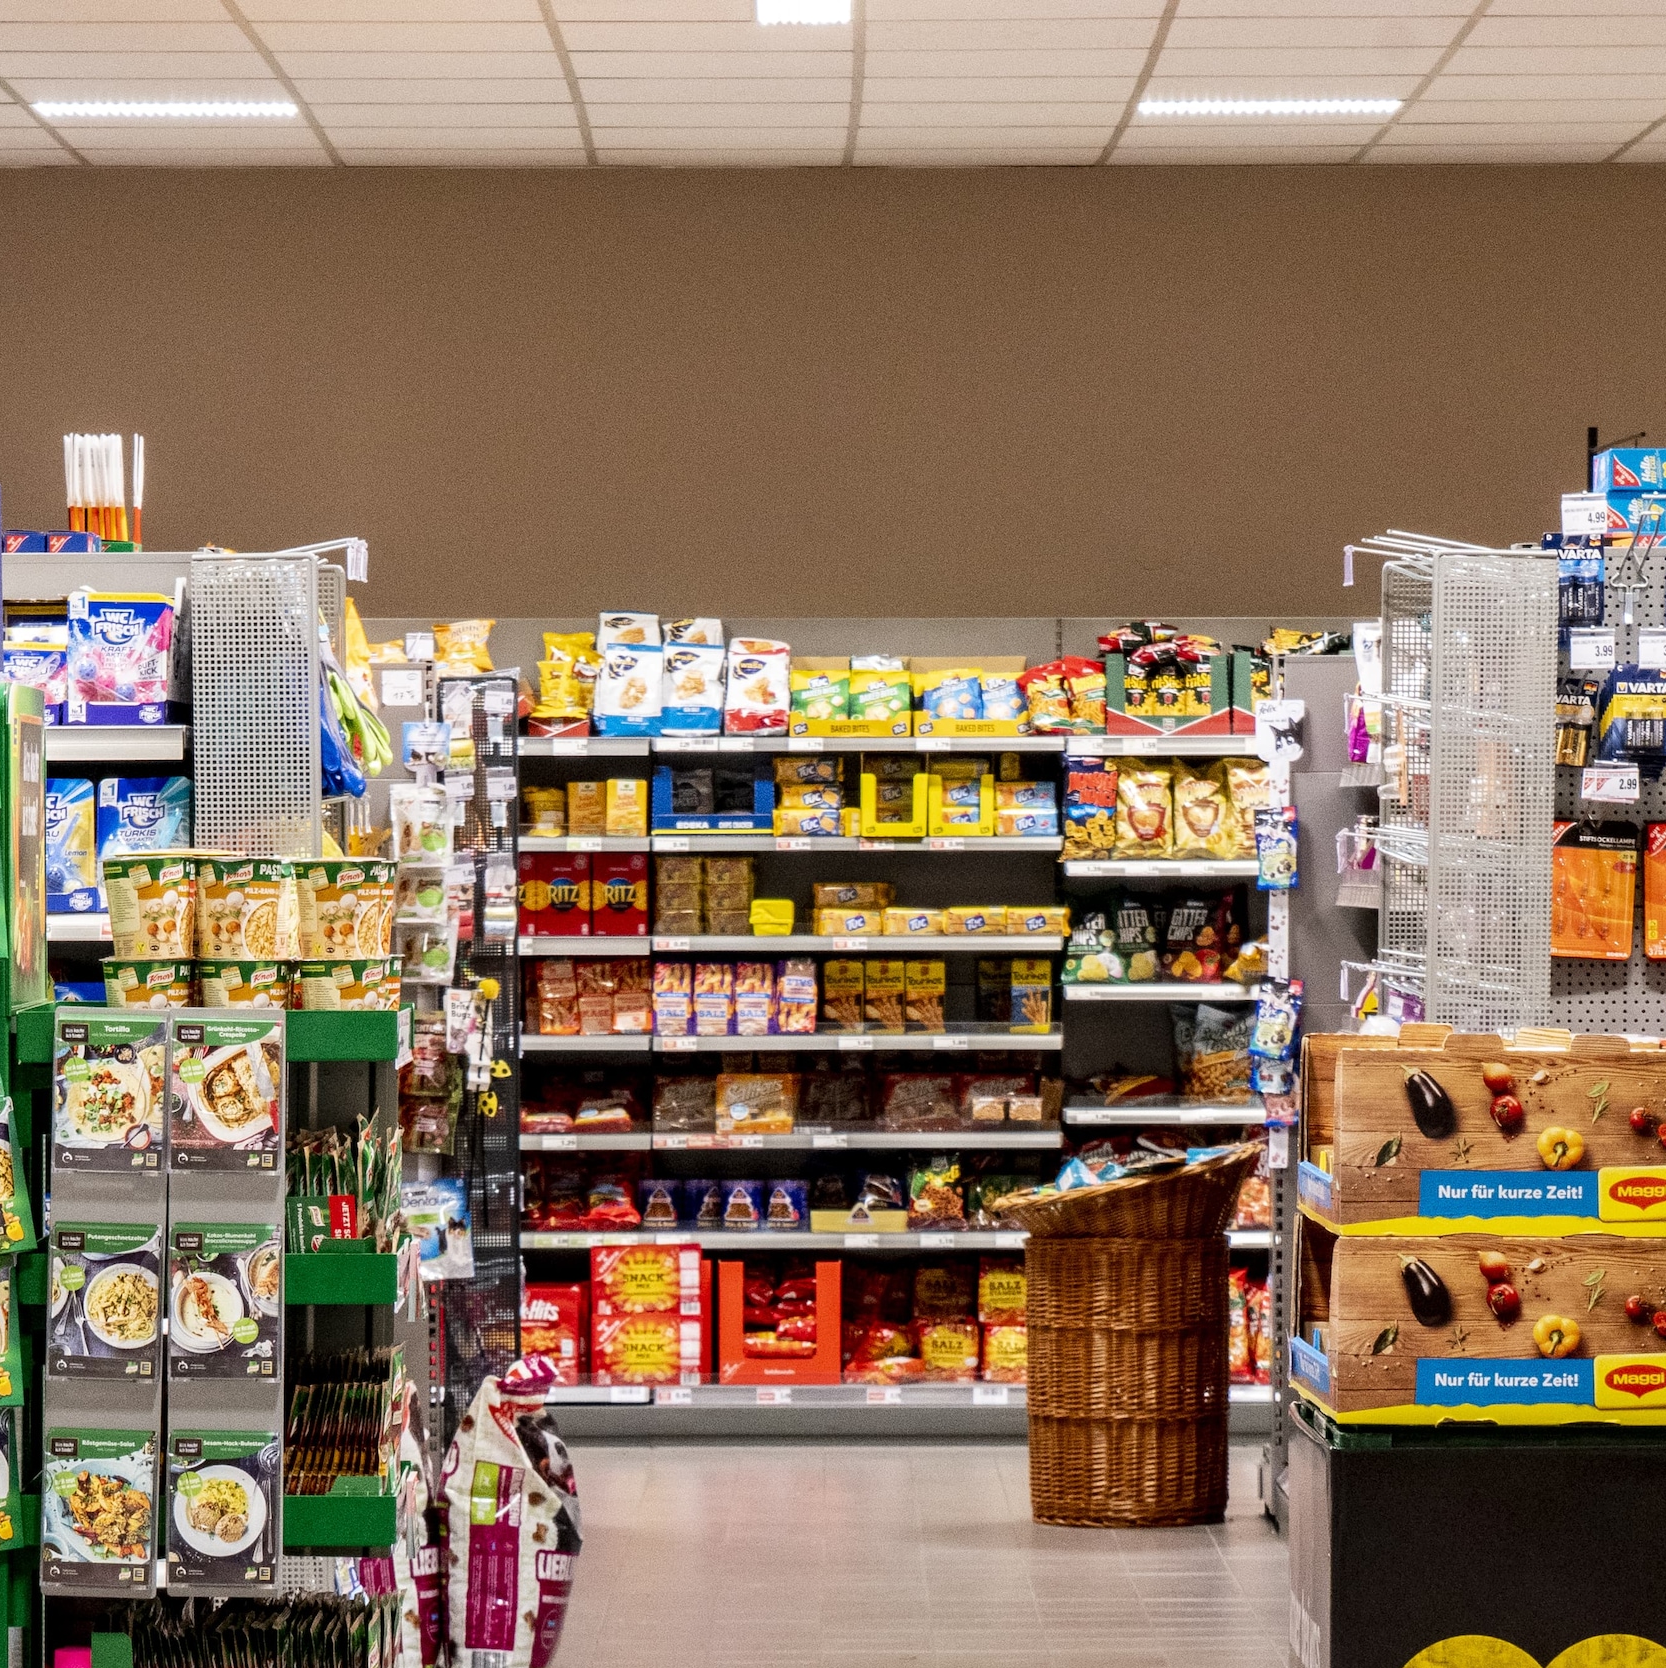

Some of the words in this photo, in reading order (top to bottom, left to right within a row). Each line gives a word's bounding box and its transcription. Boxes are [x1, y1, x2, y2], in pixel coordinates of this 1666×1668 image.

[1587, 512, 1606, 524] 4.99
[104, 612, 130, 625] WC
[96, 622, 139, 636] FRISCH
[1595, 645, 1613, 657] 3.99
[1619, 778, 1637, 790] 2.99
[133, 796, 155, 808] WC
[123, 805, 165, 819] FRISCH
[801, 818, 820, 831] TUC
[120, 828, 156, 838] TÜRKIS
[161, 868, 183, 880] Knorr
[226, 868, 252, 881] Knorr
[339, 870, 364, 882] Knorr
[548, 886, 579, 903] RITZ
[605, 886, 635, 903] RITZ
[846, 917, 865, 930] TUC
[150, 972, 175, 984] Knorr
[254, 972, 278, 984] Knorr
[451, 1003, 470, 1011] Brite
[451, 1010, 472, 1020] Bugz
[658, 1009, 685, 1018] SALZ
[698, 1009, 726, 1018] SALZ
[740, 1009, 766, 1018] SALZ
[104, 1025, 130, 1033] Tortilla
[1438, 1185, 1468, 1199] Nur
[1471, 1184, 1495, 1199] für
[1498, 1184, 1542, 1199] kurze
[1546, 1185, 1583, 1199] Zeit!
[623, 1274, 665, 1283] SNACK
[623, 1344, 665, 1352] SNACK
[1434, 1373, 1465, 1387] Nur
[1467, 1372, 1491, 1387] für
[1494, 1372, 1539, 1387] kurze
[1542, 1373, 1579, 1387] Zeit!
[1613, 1372, 1665, 1385] Maggi
